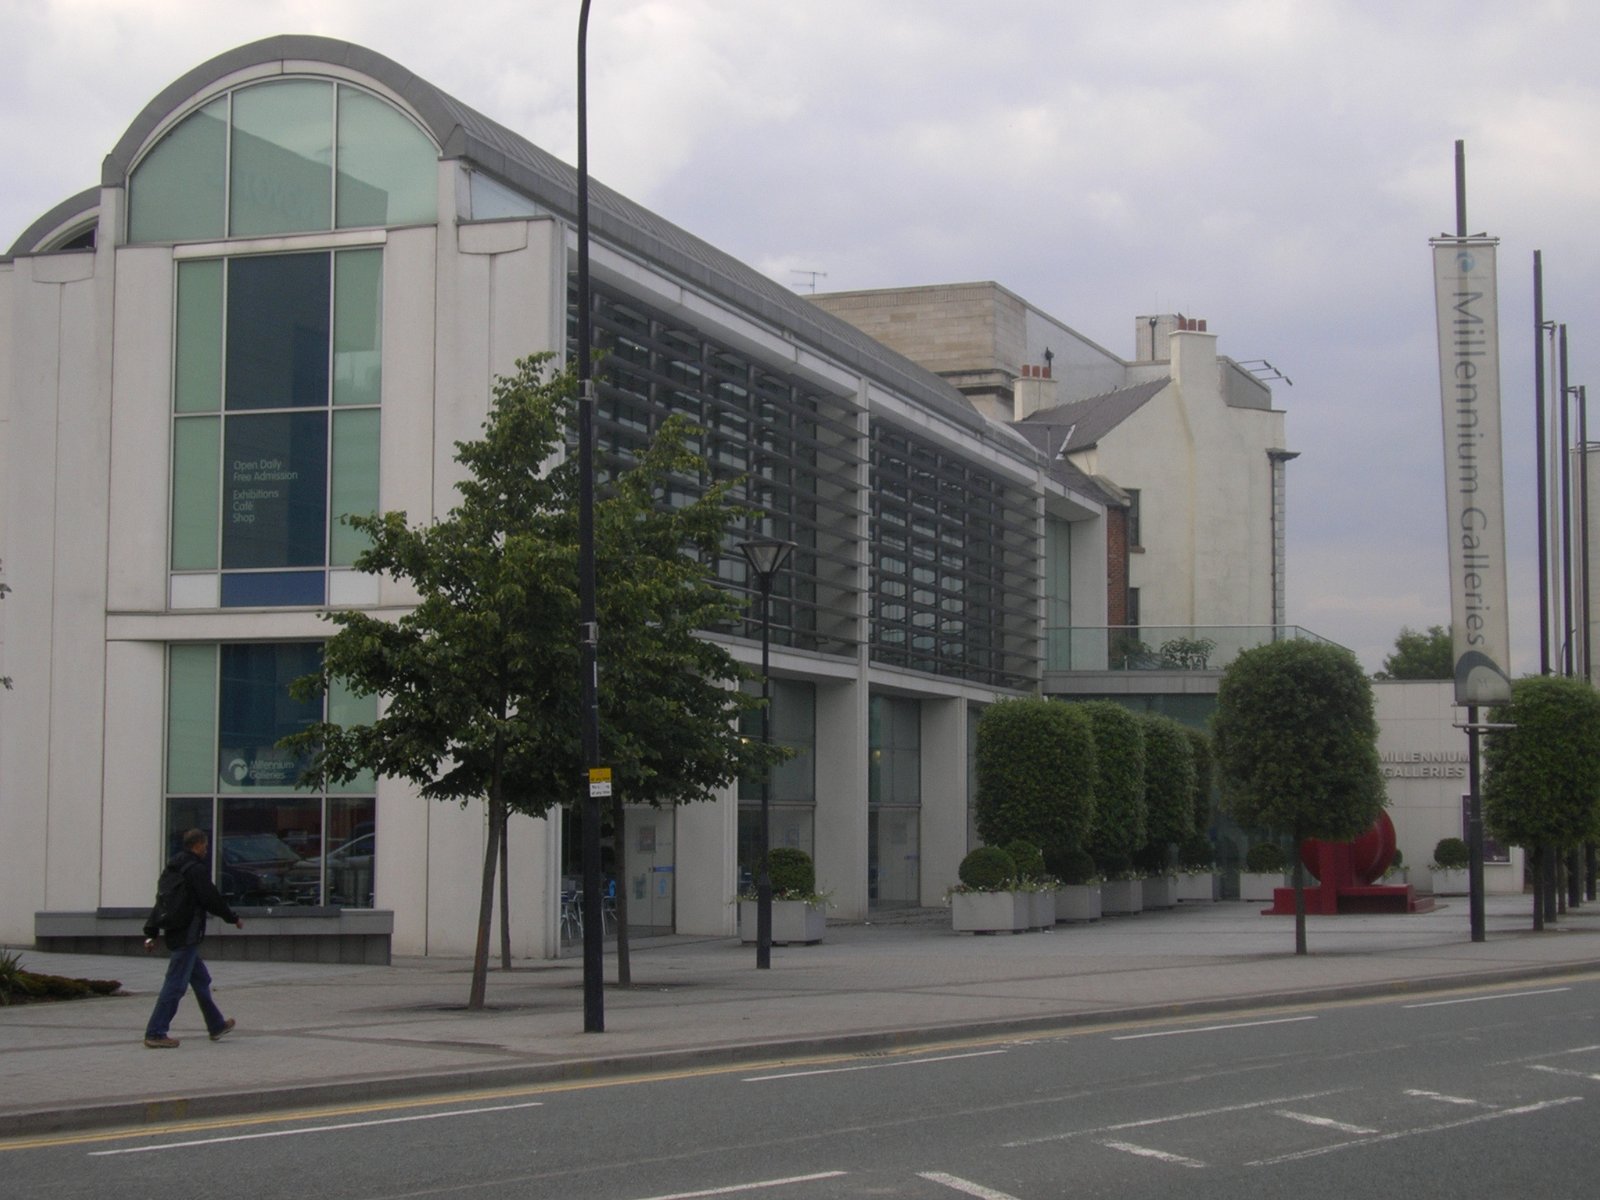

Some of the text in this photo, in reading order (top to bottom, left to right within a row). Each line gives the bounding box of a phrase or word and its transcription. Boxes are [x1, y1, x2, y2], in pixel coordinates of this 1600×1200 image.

[1452, 291, 1486, 493] Millennium
[234, 459, 282, 472] Open Daily
[233, 471, 299, 482] Free Admission
[233, 488, 280, 499] Exhibitions
[233, 512, 255, 524] Shop
[1460, 507, 1490, 646] Galleries
[1383, 765, 1465, 779] GALLERIES
